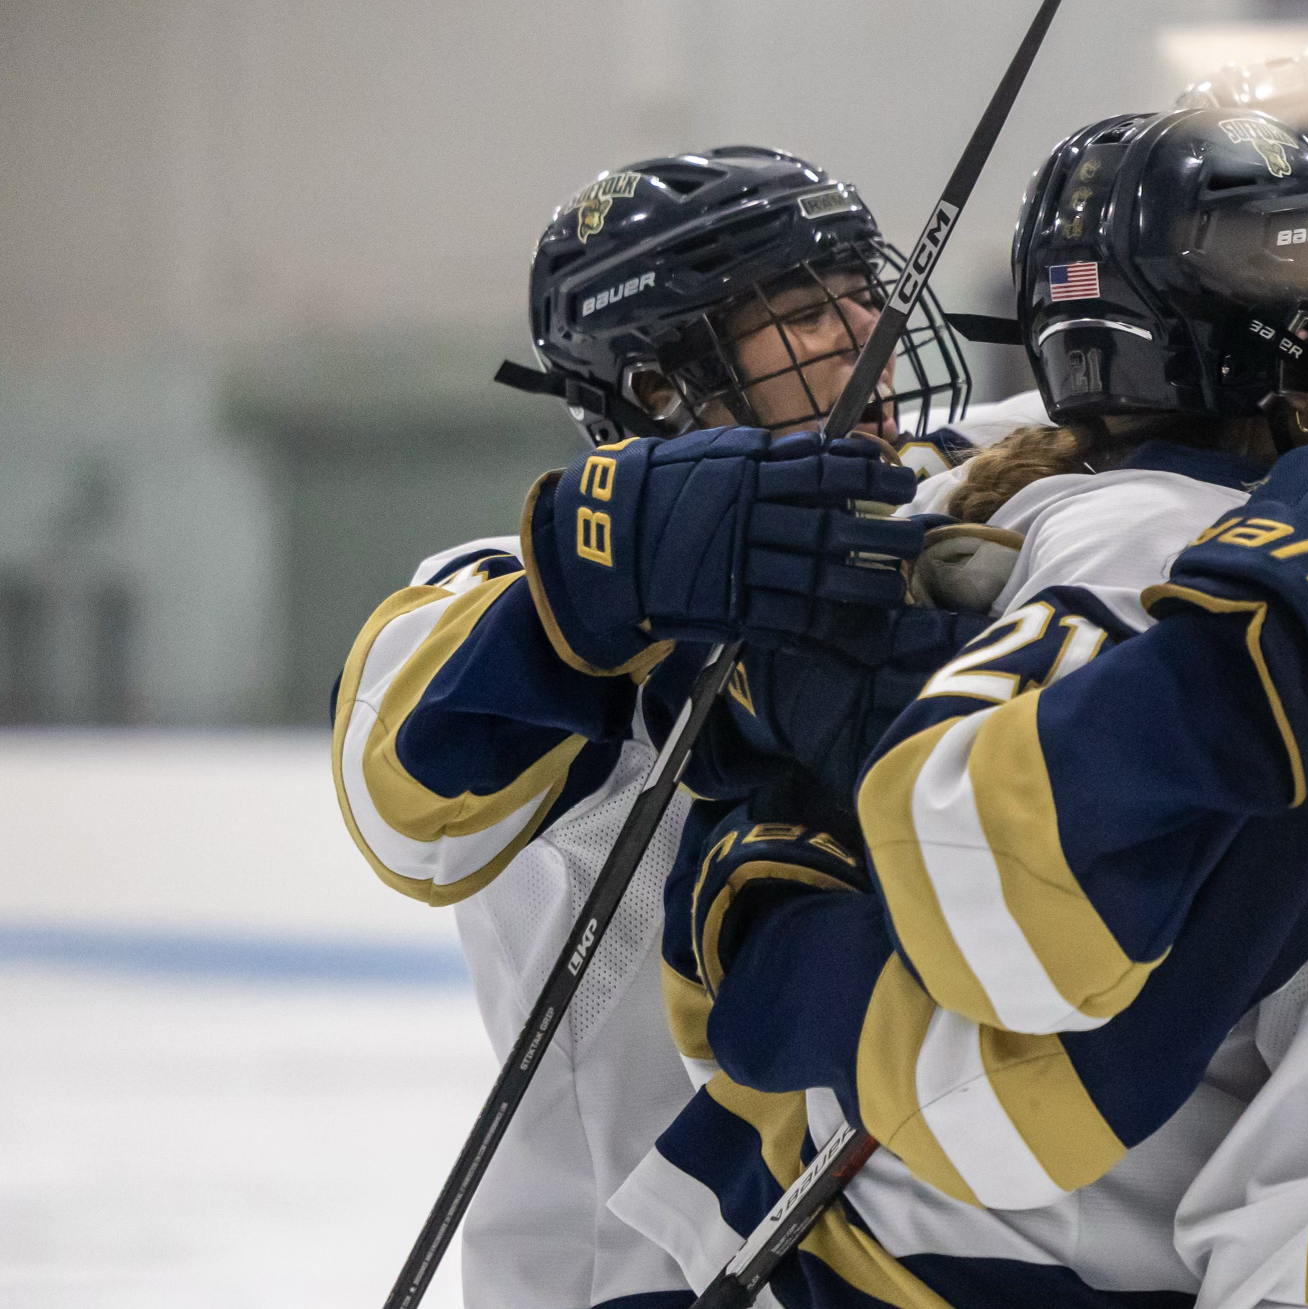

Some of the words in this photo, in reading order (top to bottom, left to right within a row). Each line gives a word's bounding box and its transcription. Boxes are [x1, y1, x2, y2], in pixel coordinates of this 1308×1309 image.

[899, 211, 952, 306] CCM
[1249, 319, 1303, 359] BAER
[1069, 348, 1103, 395] 21
[916, 600, 1108, 706] 21
[540, 1006, 555, 1031] GRIP
